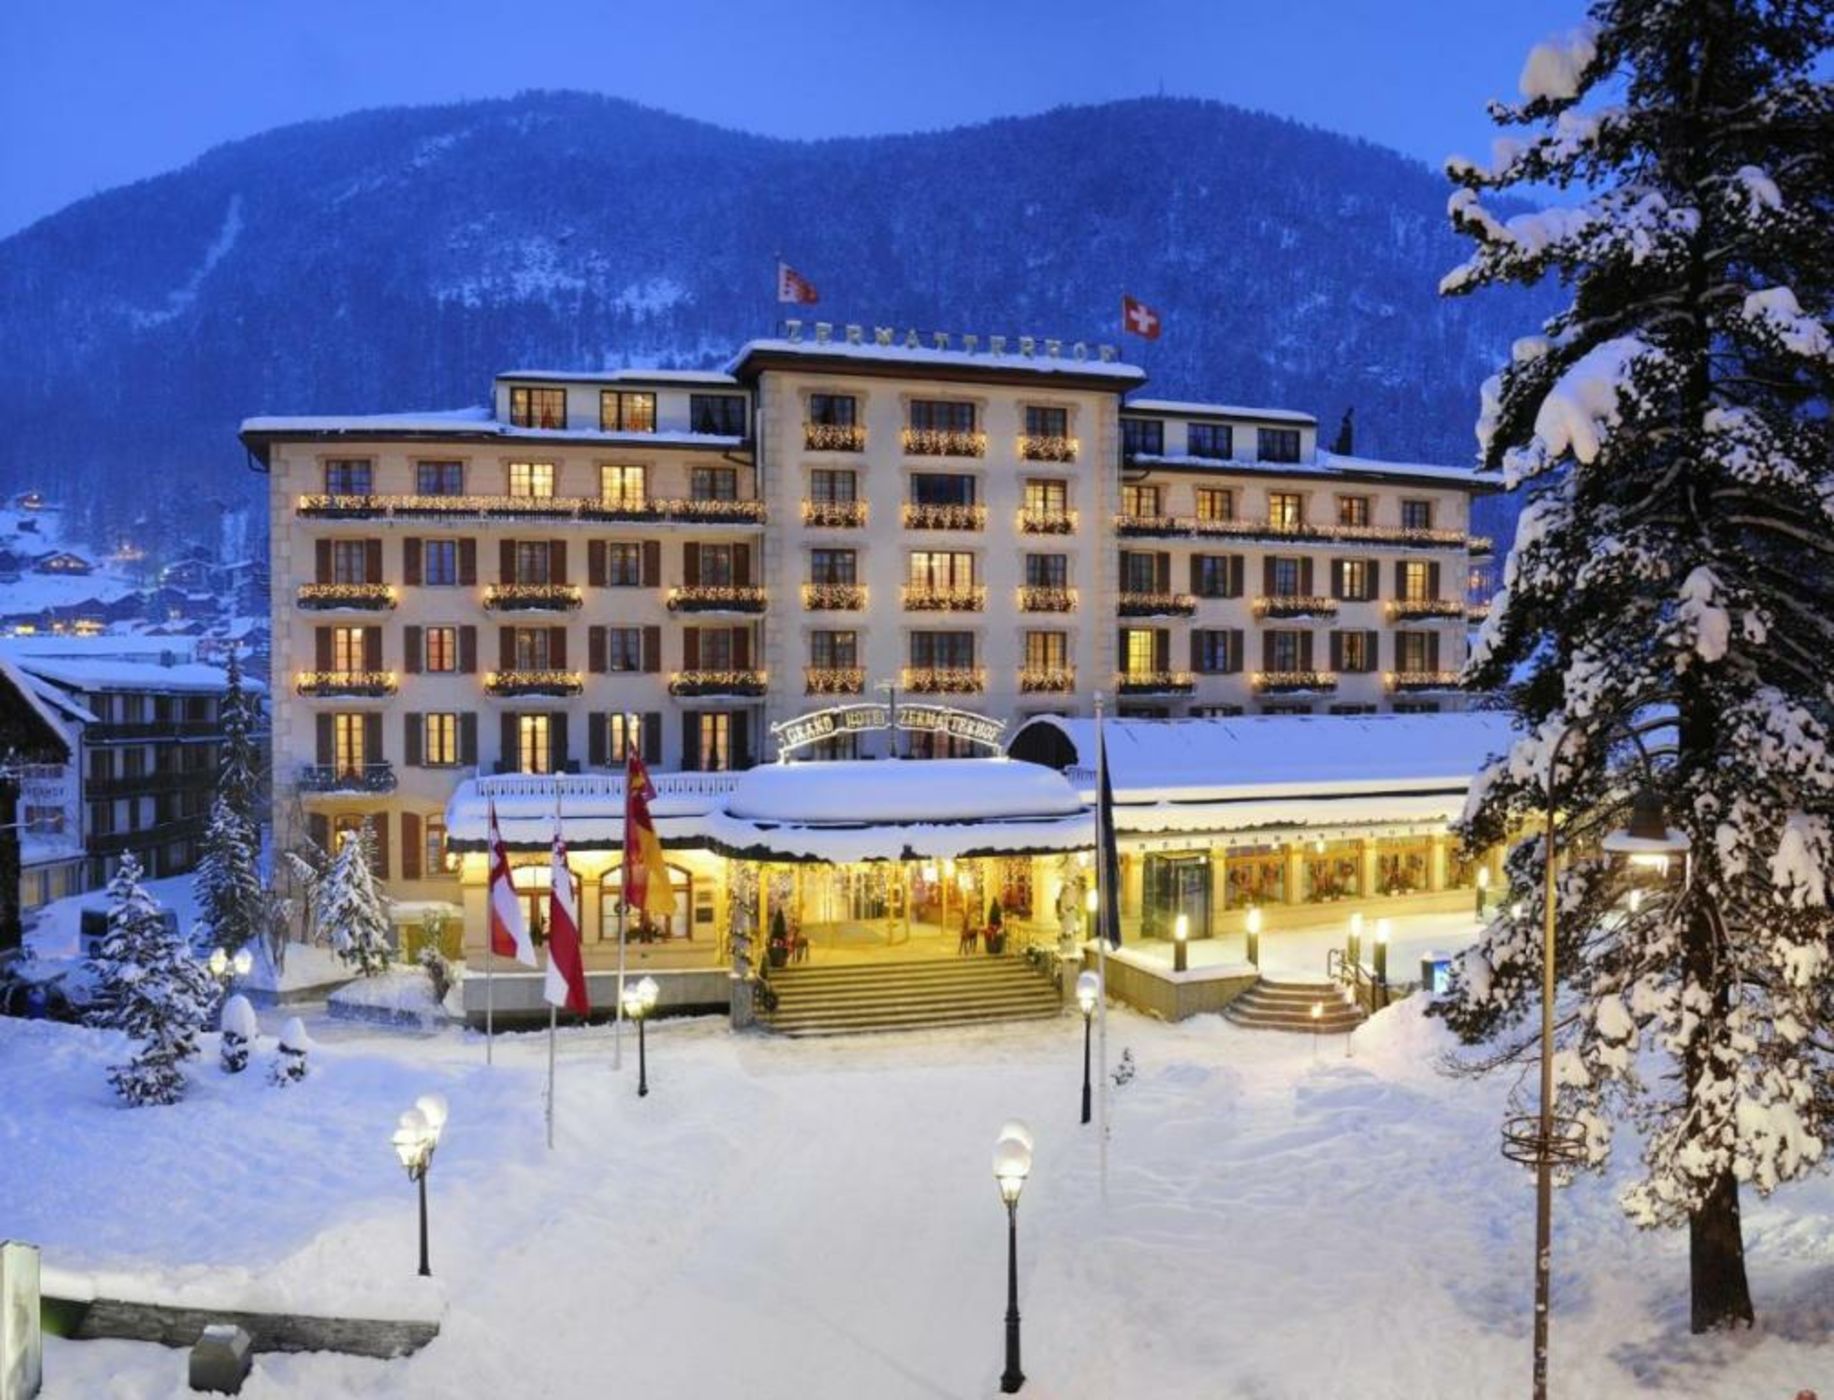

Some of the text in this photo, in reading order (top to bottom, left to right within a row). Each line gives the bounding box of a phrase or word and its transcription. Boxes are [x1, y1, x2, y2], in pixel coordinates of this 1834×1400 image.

[786, 709, 999, 745] GRAND HOTEL ZERMATTERHOF
